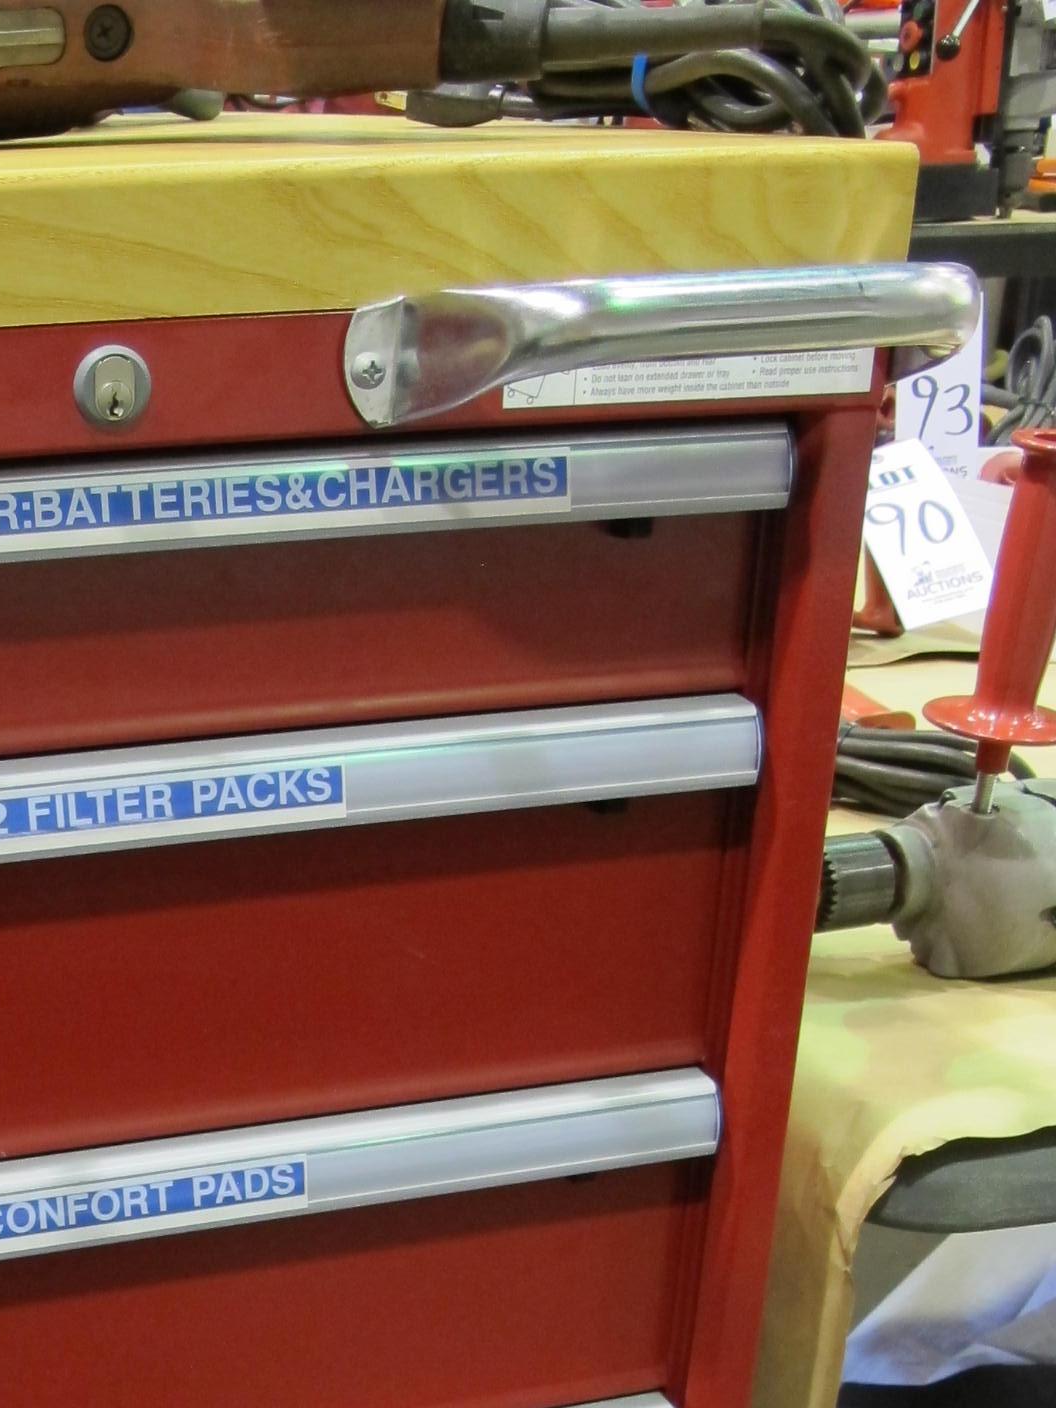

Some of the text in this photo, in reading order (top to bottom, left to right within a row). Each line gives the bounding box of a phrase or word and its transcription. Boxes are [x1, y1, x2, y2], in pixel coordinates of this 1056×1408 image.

[912, 375, 973, 440] 93
[865, 500, 955, 556] 90
[907, 571, 984, 600] AUCTIONS
[27, 783, 174, 833] FILTER
[192, 767, 333, 815] PACKS
[192, 1165, 296, 1208] PADS
